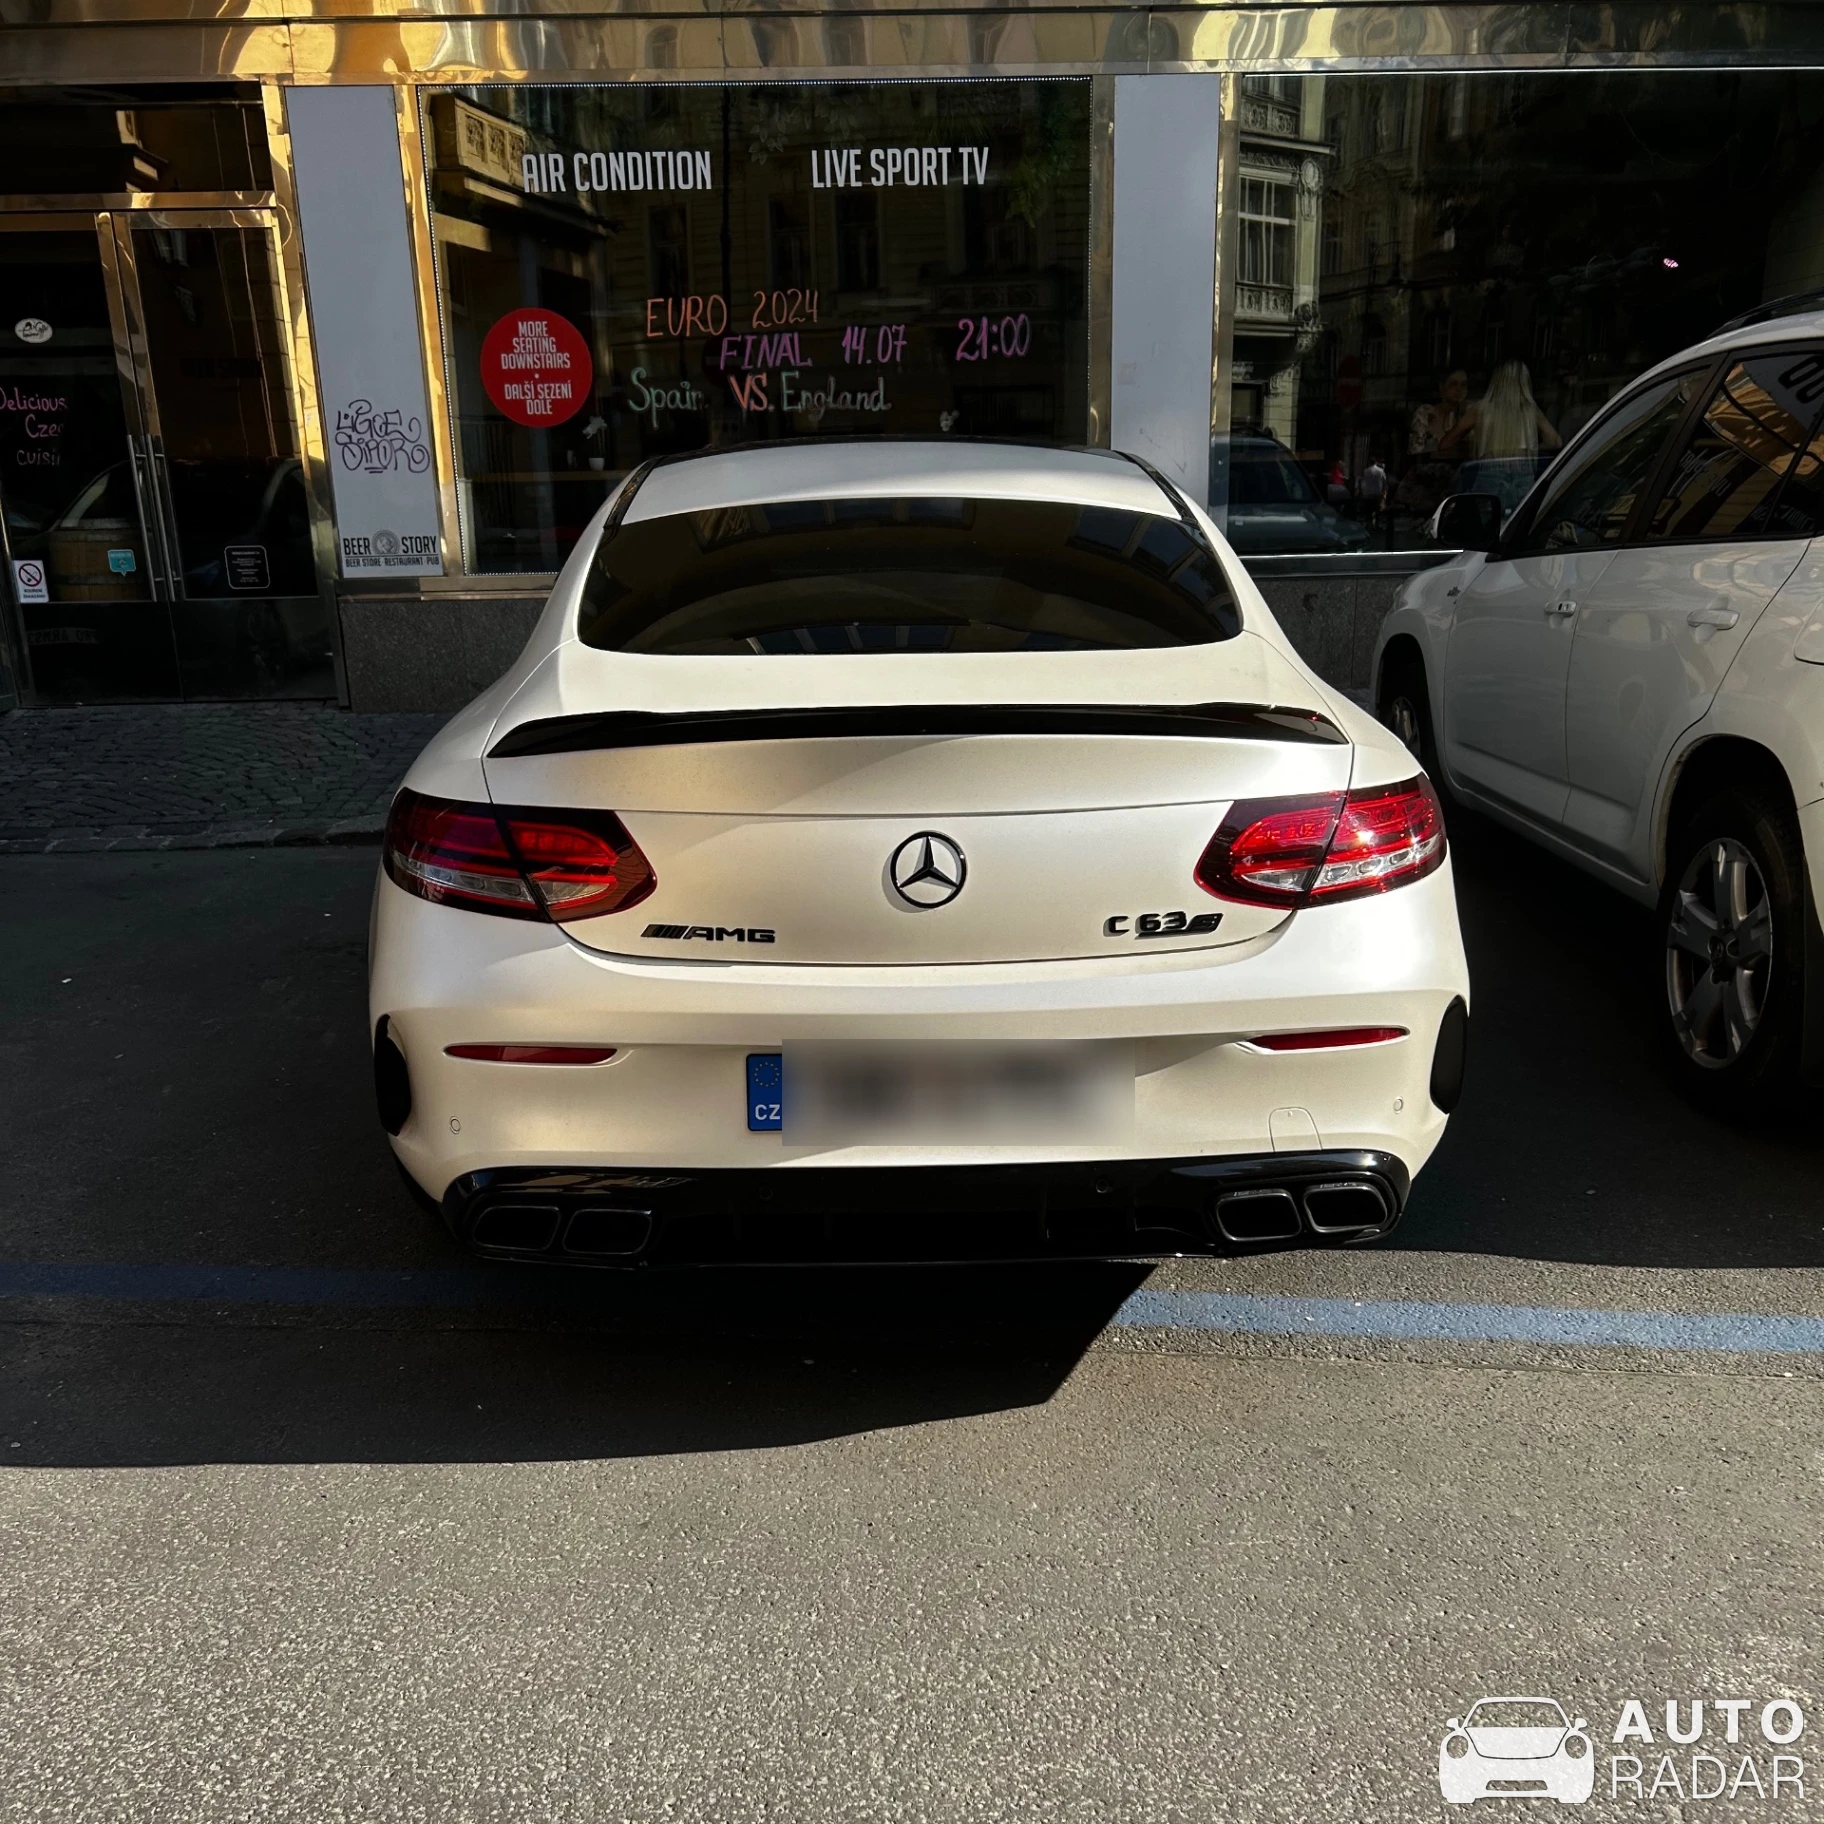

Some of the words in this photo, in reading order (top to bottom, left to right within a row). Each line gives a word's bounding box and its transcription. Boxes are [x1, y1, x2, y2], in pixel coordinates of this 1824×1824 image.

[521, 153, 567, 193] AIR
[573, 150, 713, 192] CONDITION
[811, 148, 863, 188] LIVE
[869, 147, 952, 187] SPORT
[958, 146, 990, 186] TV
[646, 294, 728, 337] EURO
[752, 288, 819, 329] 2024
[518, 321, 549, 337] MORE
[512, 337, 557, 353] SEATING
[719, 331, 814, 371] FINAL
[841, 324, 908, 365] 14.07
[955, 313, 1032, 361] 21:00
[501, 353, 571, 370] DOWNSTAIRS
[504, 380, 536, 400] DALŠÍ
[537, 380, 573, 399] SEZENÍ
[780, 370, 893, 423] England
[526, 399, 553, 415] DOLE
[343, 537, 371, 555] BEER
[401, 536, 437, 554] STORY
[345, 558, 361, 568] BEER
[362, 558, 382, 567] STORE
[384, 557, 424, 566] RESTAURANT
[426, 556, 440, 566] PUB
[1107, 915, 1130, 934] C
[681, 925, 776, 944] AMG
[754, 1103, 781, 1121] CZ
